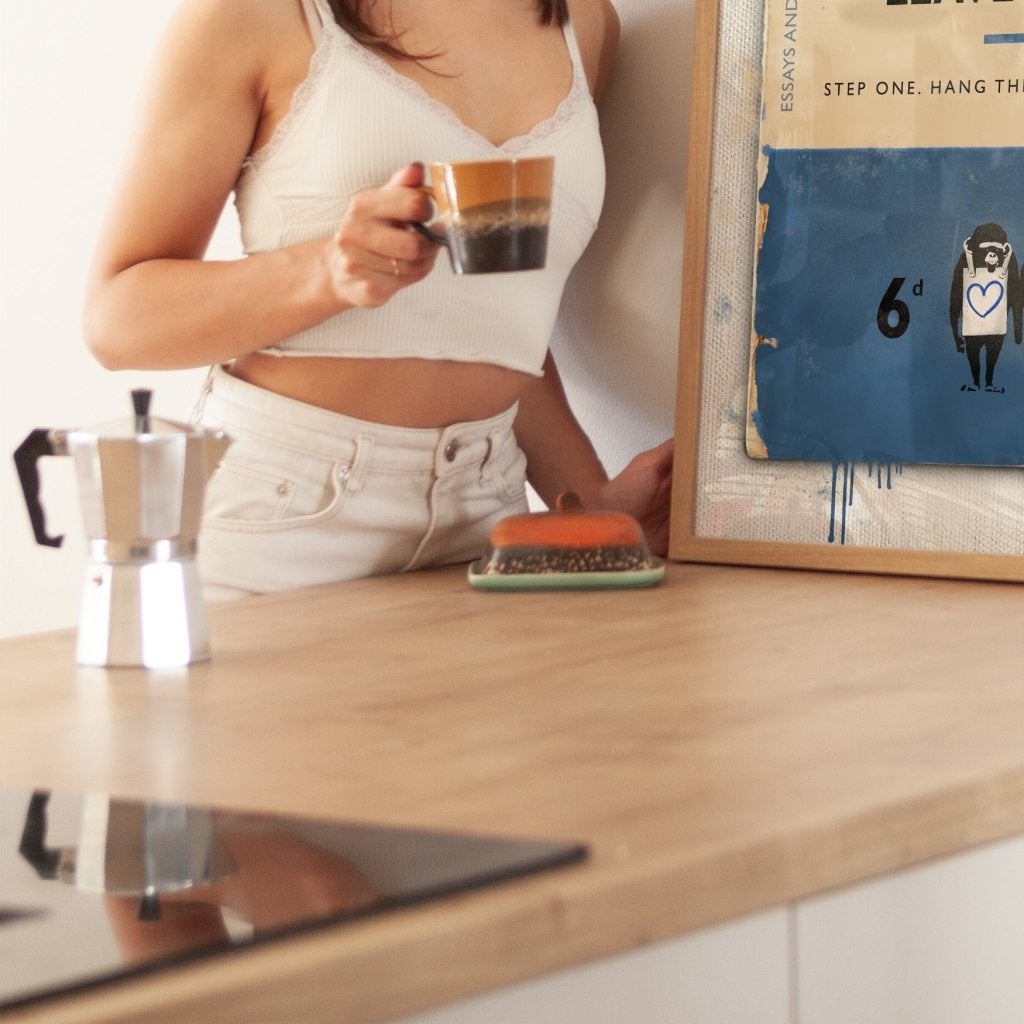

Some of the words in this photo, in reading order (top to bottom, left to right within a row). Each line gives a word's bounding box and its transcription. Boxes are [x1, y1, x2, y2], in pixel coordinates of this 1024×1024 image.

[780, 47, 796, 112] ESSAYS
[824, 82, 866, 96] STEP
[876, 80, 921, 96] ONE.
[930, 79, 986, 95] HANG
